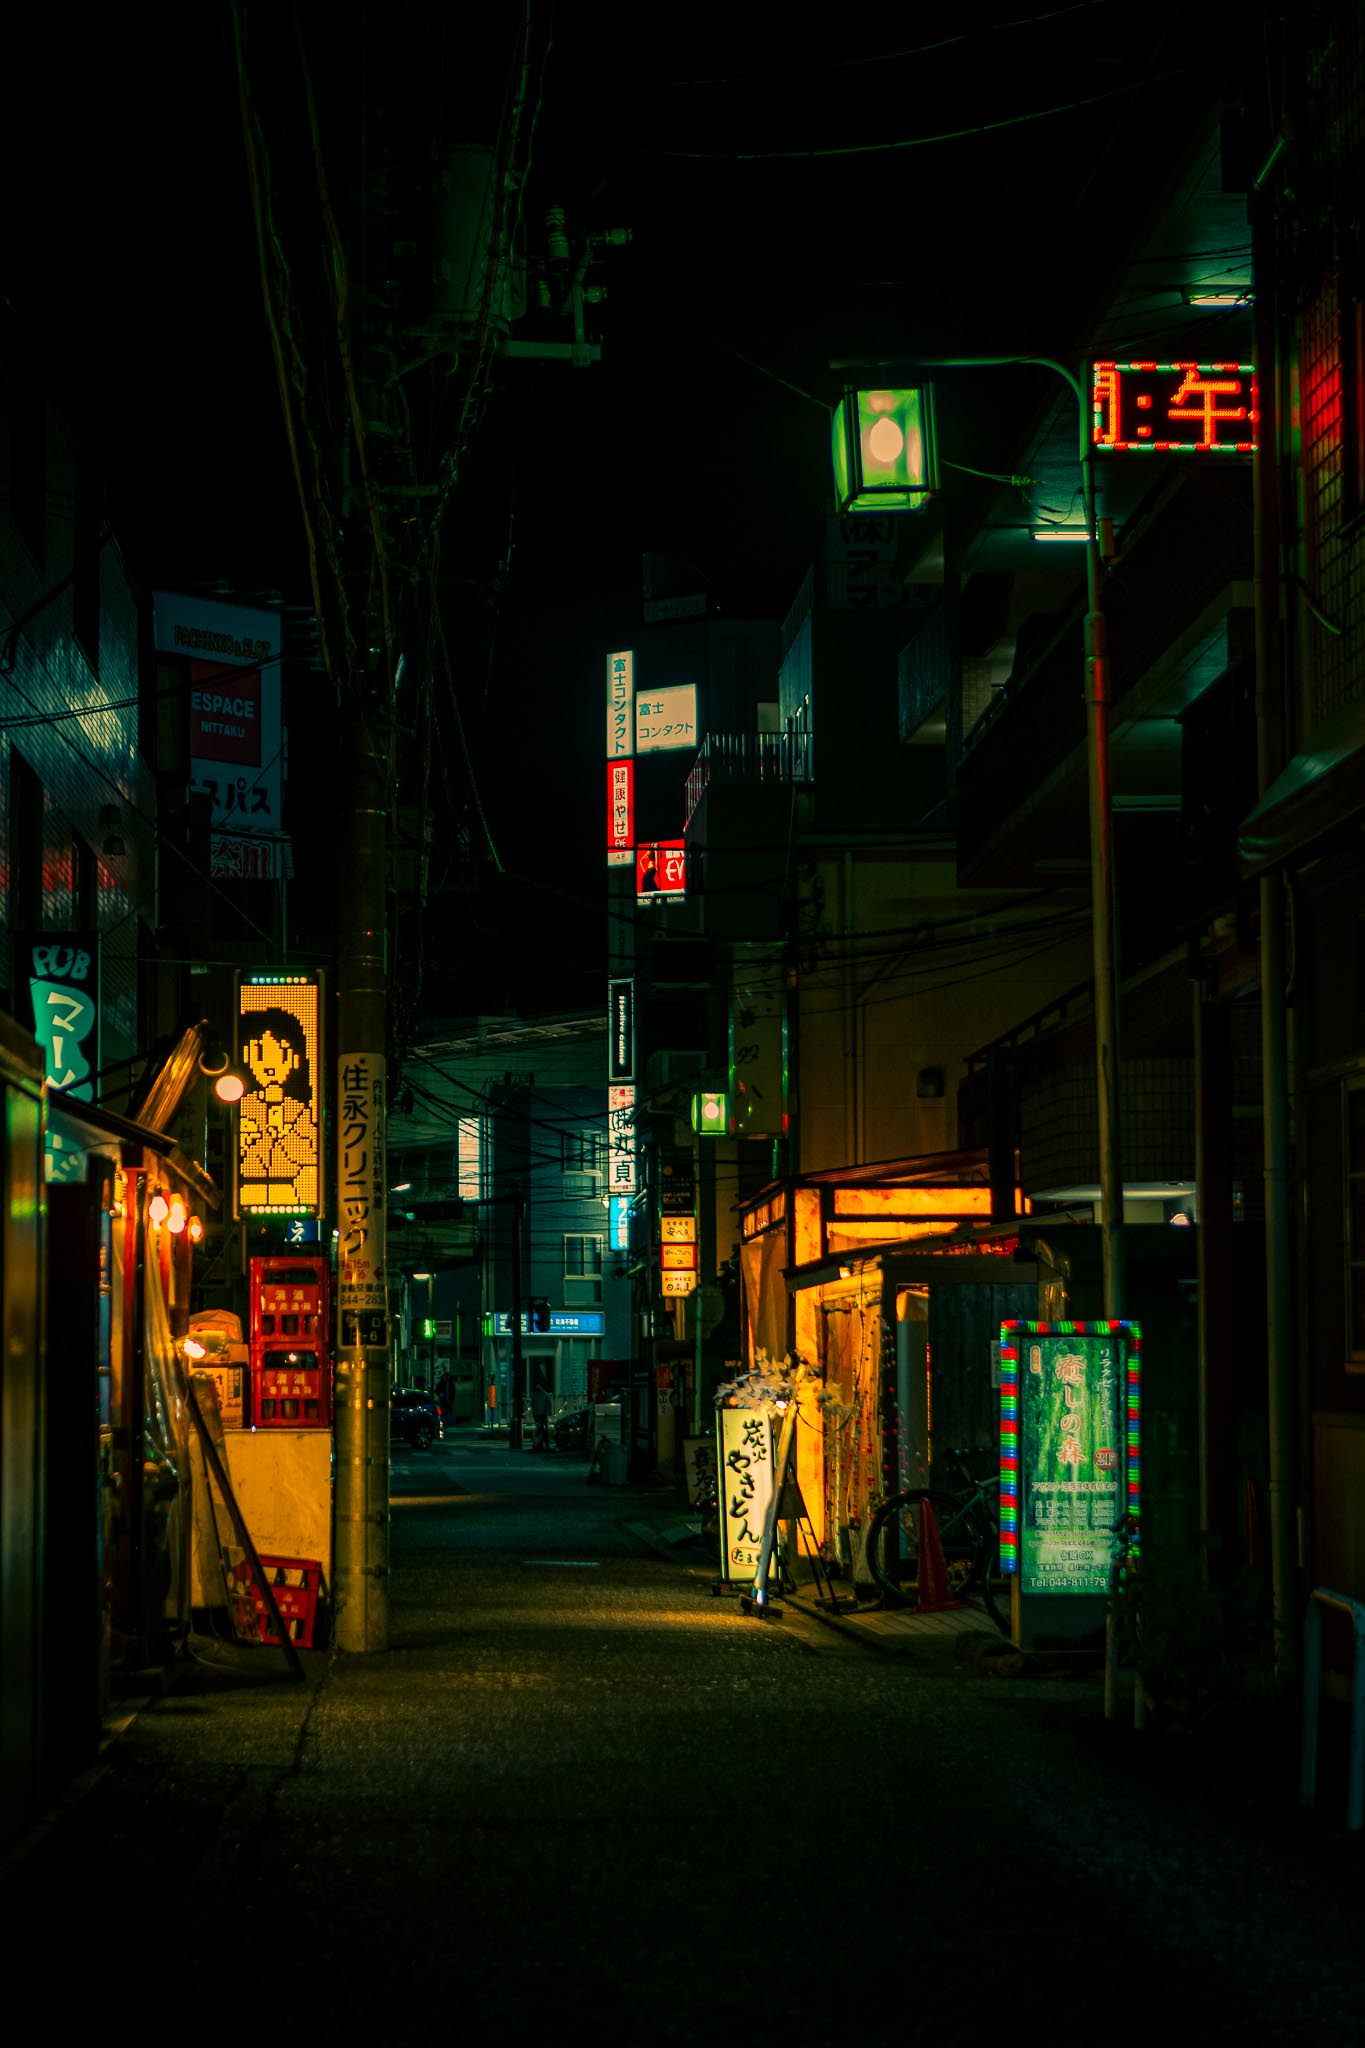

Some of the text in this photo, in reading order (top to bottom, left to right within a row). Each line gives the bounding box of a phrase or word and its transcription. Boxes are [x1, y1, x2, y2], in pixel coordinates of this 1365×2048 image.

[190, 690, 256, 720] ESPACE
[613, 658, 626, 754] 富士コンタクト
[639, 701, 665, 716] 富士
[200, 719, 245, 739] NITTAKU
[639, 722, 694, 739] コンタクト
[32, 945, 93, 983] PUB
[341, 1064, 369, 1254] 住永クリニック
[1099, 1348, 1113, 1428] リラクゼーション
[1055, 1353, 1085, 1465] 癒しの森
[743, 1419, 767, 1463] 炭火
[1096, 1452, 1115, 1466] 2F
[726, 1449, 762, 1543] やきとん
[733, 1549, 761, 1564] たま
[1030, 1576, 1108, 1588] Tel.044-811-79
